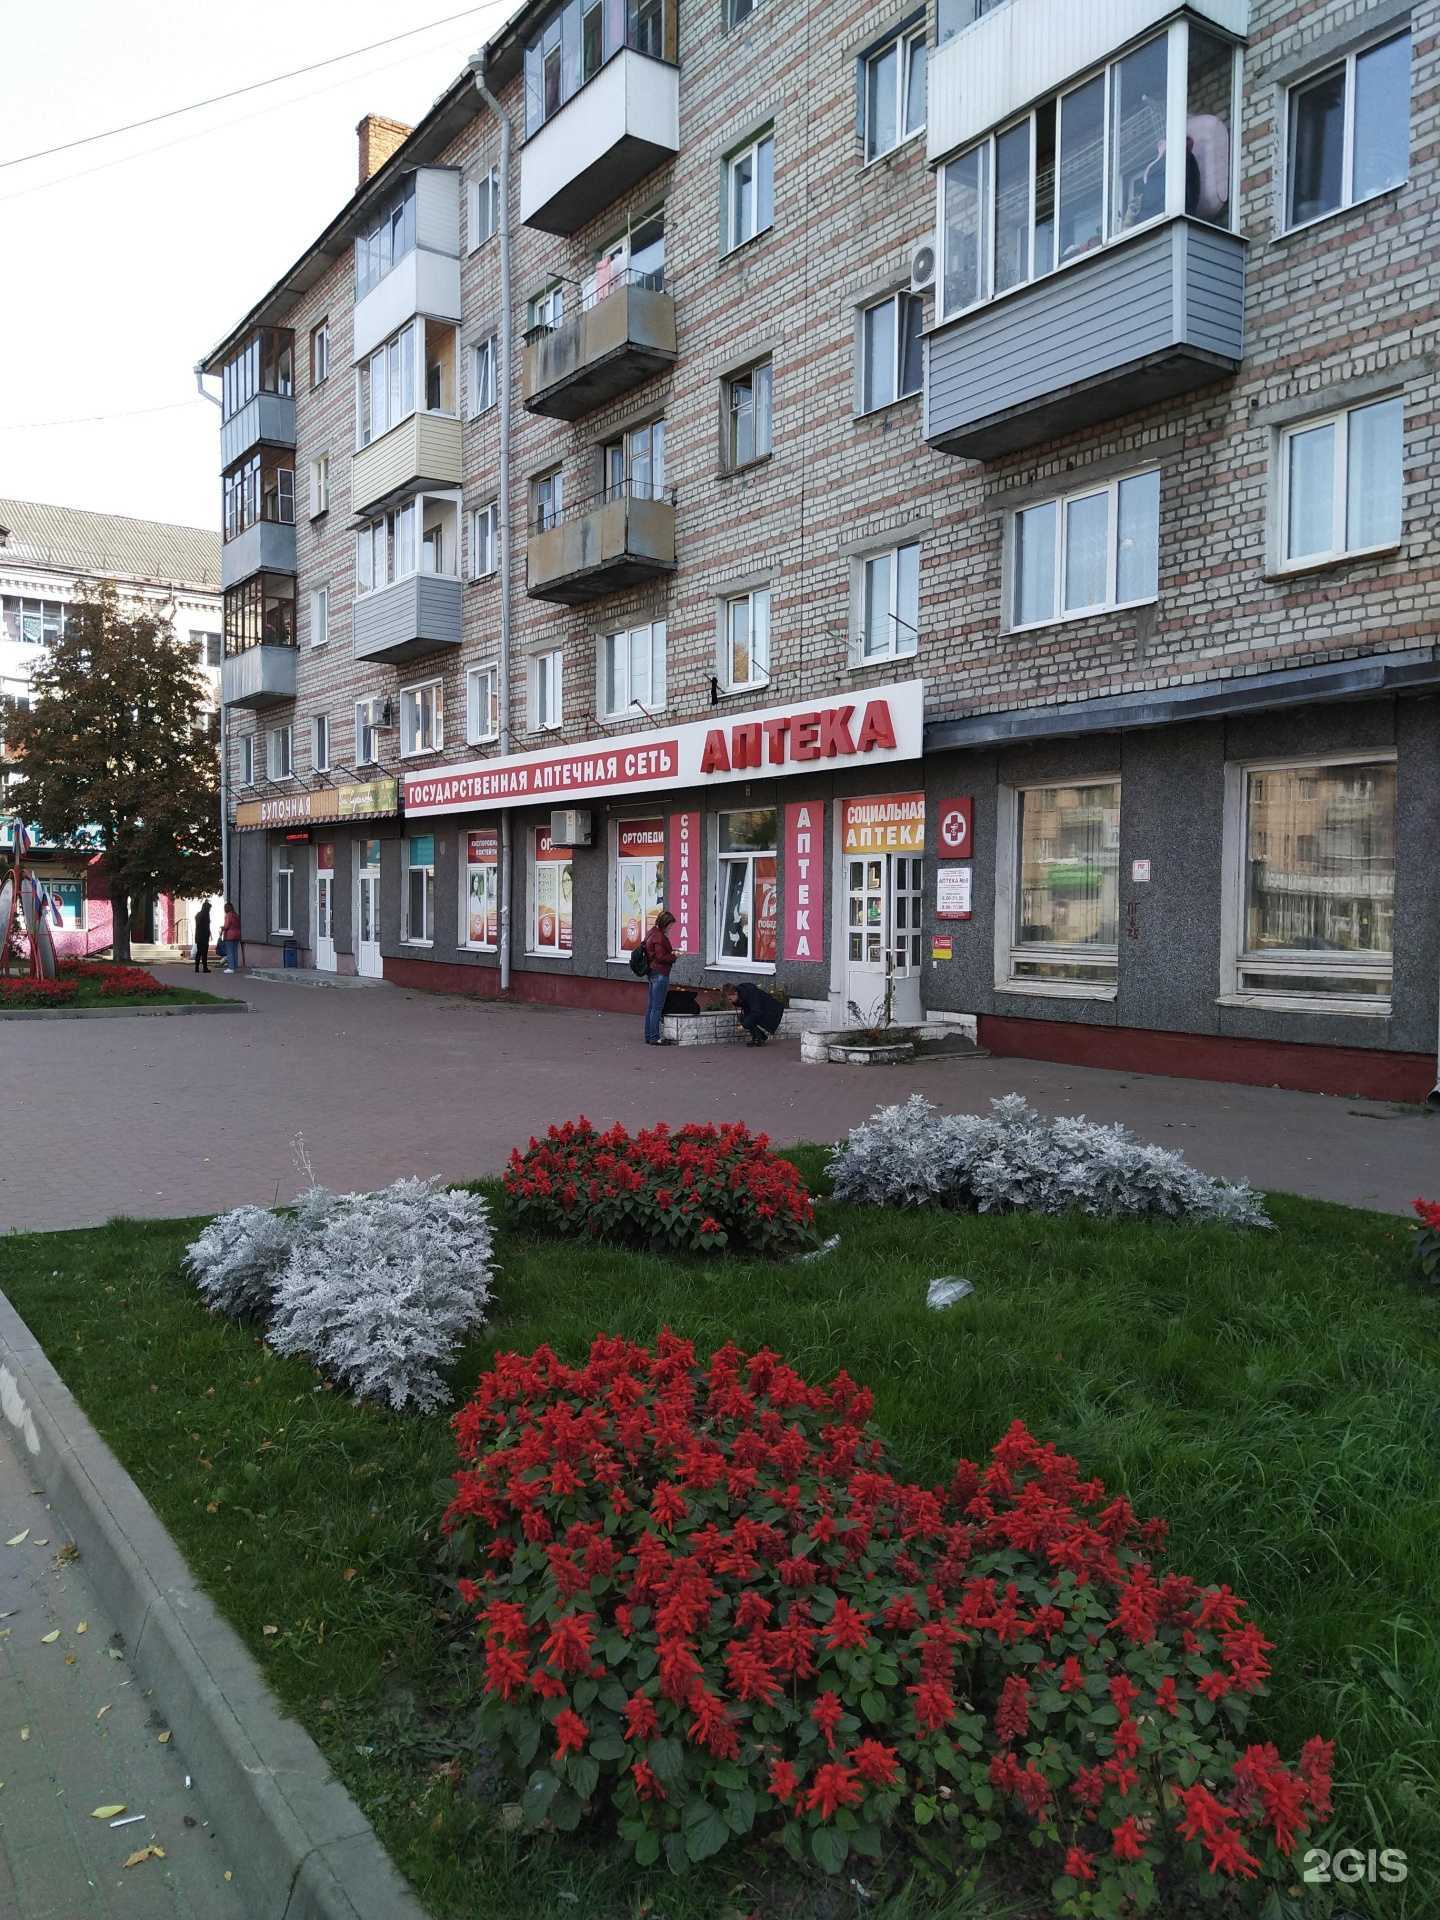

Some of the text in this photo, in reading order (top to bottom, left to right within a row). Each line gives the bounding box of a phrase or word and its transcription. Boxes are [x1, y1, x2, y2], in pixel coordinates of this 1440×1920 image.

[700, 700, 898, 774] АПТЕКА
[261, 796, 311, 821] БУЛОЧНАЯ
[409, 770, 528, 804] ГОСУДАРСТВЕННАЯ
[533, 756, 618, 789] АПТЕЧНАЯ
[624, 749, 672, 777] СЕТЬ
[847, 800, 925, 825] СОЦИАЛЬНАЯ
[680, 814, 689, 952] СОЦИАЛЬНАЯ
[796, 807, 811, 956] АПТЕКА
